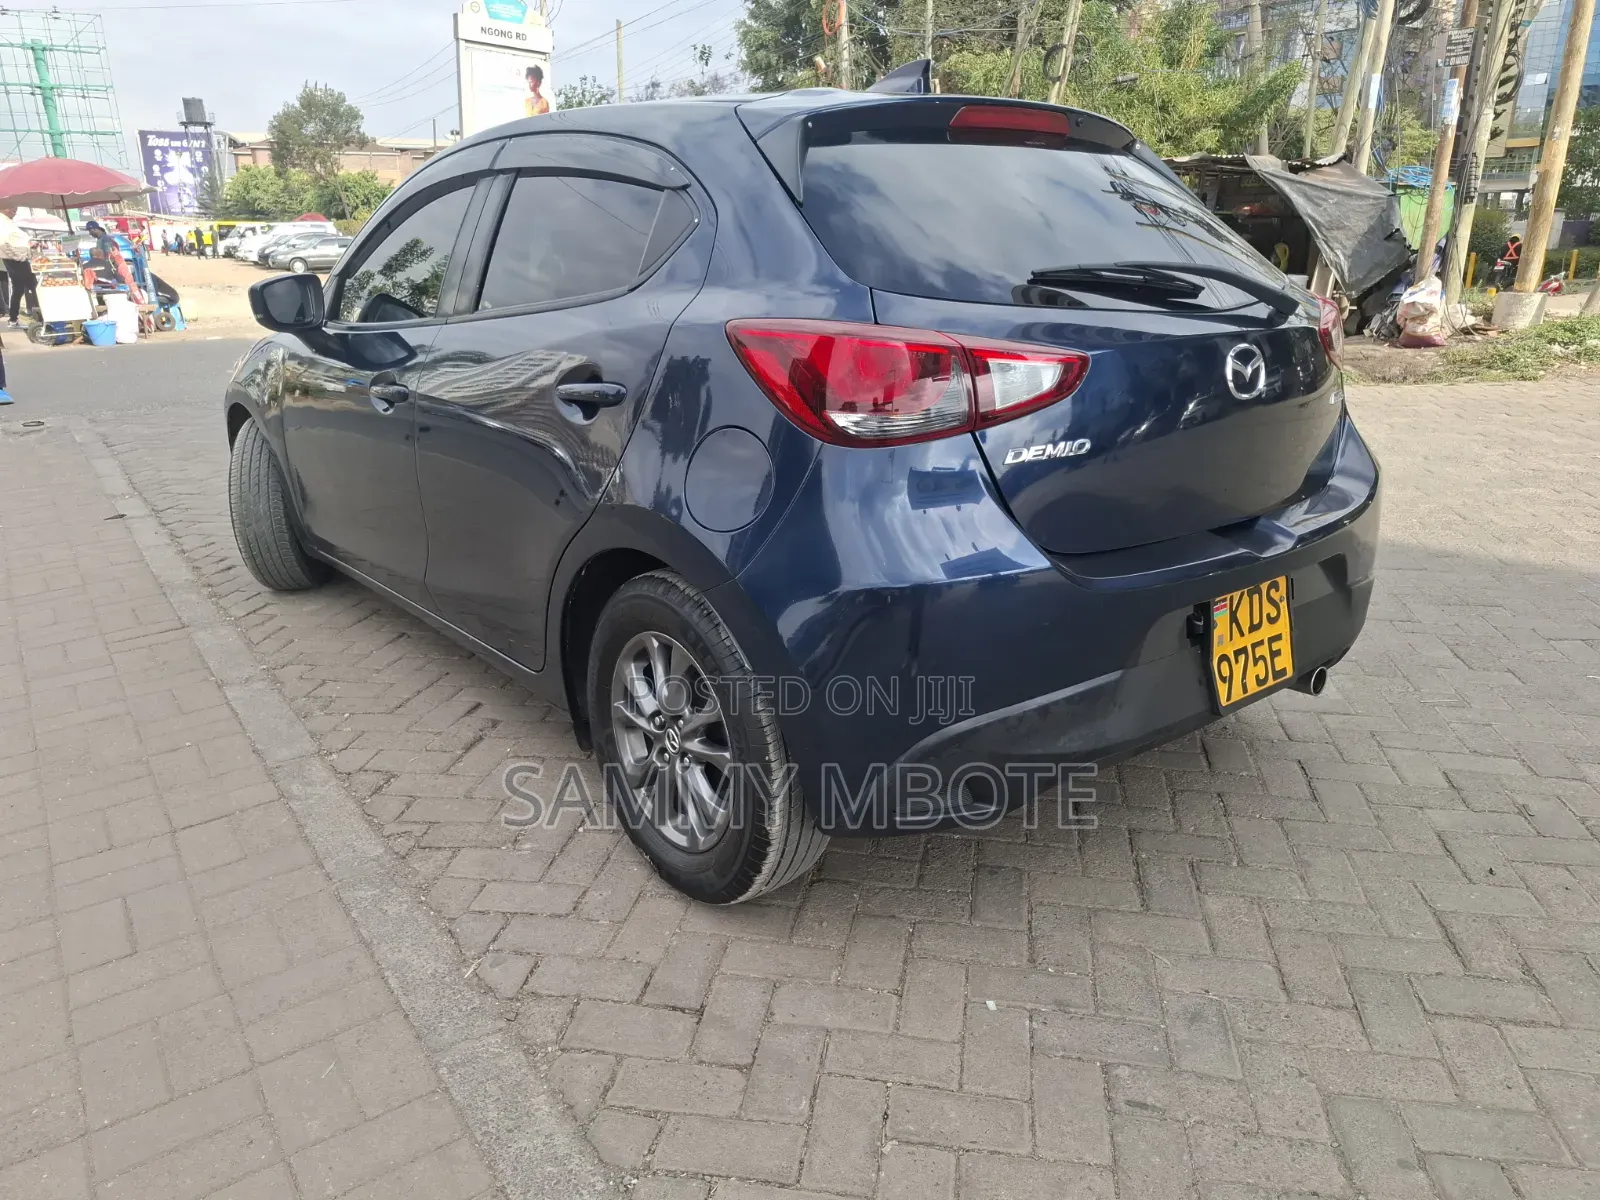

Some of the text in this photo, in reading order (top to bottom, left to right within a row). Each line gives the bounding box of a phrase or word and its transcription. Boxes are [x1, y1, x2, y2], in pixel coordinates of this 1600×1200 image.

[481, 26, 527, 41] NGONG RD
[1003, 438, 1091, 465] DEMIO
[1228, 579, 1282, 642] KDS
[1216, 632, 1288, 702] 975E
